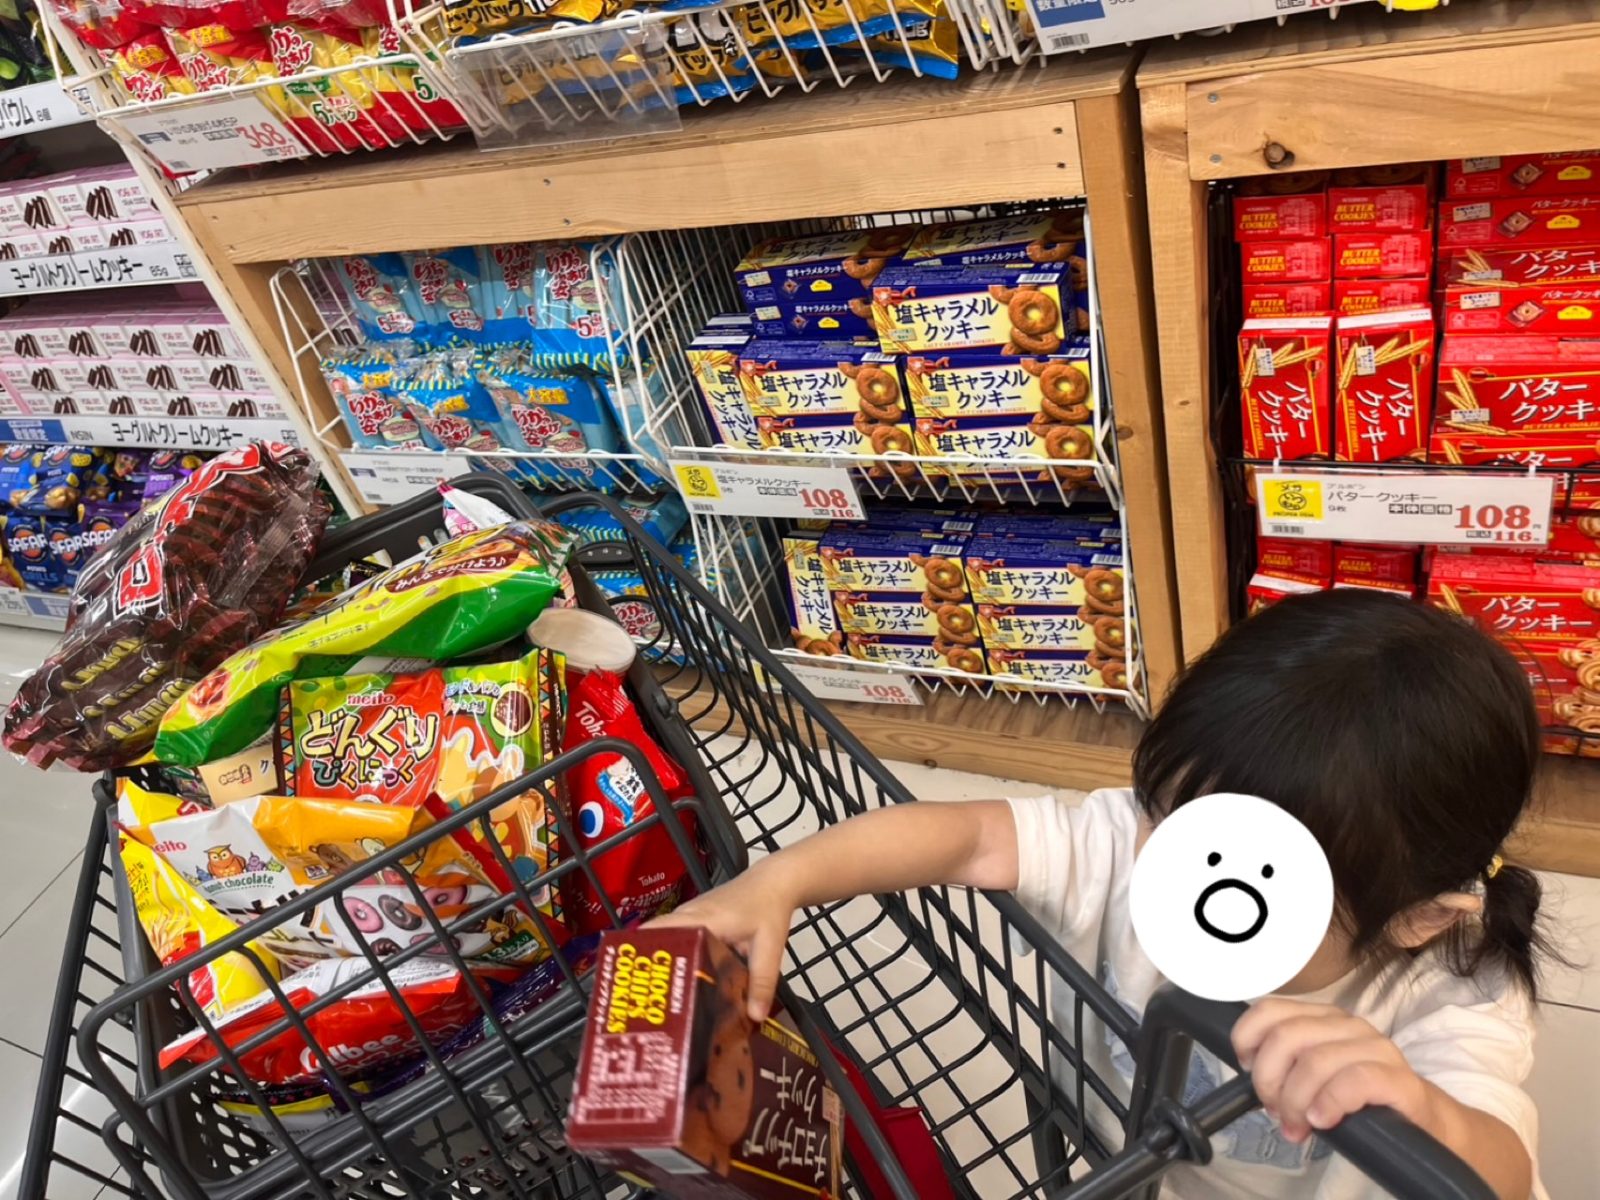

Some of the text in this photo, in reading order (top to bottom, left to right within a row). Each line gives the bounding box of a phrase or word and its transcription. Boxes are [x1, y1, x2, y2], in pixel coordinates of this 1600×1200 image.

[235, 122, 287, 149] 368
[10, 255, 143, 289] ヨーグルトクリームクッキー
[896, 298, 999, 324] 塩キャラメル
[924, 323, 990, 342] クッキー
[761, 372, 847, 393] 塩キャラメル
[928, 370, 1030, 392] 塩キャラメル
[1500, 378, 1588, 400] バター
[788, 391, 842, 408] クッキー
[957, 389, 1022, 409] クッキー
[1387, 378, 1414, 436] バター
[708, 389, 739, 442] クッキー
[1285, 381, 1313, 438] バター
[1511, 399, 1600, 423] クッキ
[112, 420, 243, 447] ヨーグルトクリームクッキー
[1258, 390, 1288, 460] クッキー
[1356, 389, 1387, 462] クッキー
[777, 430, 863, 449] 塩キャラメル
[936, 431, 1036, 453] 塩キャラメル
[717, 474, 811, 488] 塩キャラメルクッキー
[799, 488, 849, 509] 108
[1328, 491, 1437, 503] バタークッキー
[831, 509, 855, 518] 116
[1455, 504, 1530, 529] 108
[1494, 530, 1532, 542] 116
[838, 560, 917, 573] 塩キャラメル
[861, 573, 912, 586] クッキー
[987, 571, 1075, 586] 塩キャラメル
[795, 575, 813, 625] クッキー
[1011, 587, 1068, 600] クッキー
[852, 606, 930, 618] 塩キャラメル
[1482, 597, 1560, 613] バター
[875, 619, 924, 630] クッキー
[998, 618, 1085, 632] 塩キャラメル
[1494, 614, 1592, 631] クッキー
[1022, 633, 1078, 645] クッキー
[864, 645, 940, 660] 塩キャラメル
[1007, 662, 1093, 676] 塩キャラメル
[347, 693, 396, 706] meito
[861, 685, 905, 698] 108
[301, 707, 439, 761] どんぐり
[313, 755, 415, 792] ぴくにっく
[150, 840, 187, 854] eito
[224, 874, 275, 890] chocolate
[639, 872, 666, 887] Tohato
[607, 943, 636, 1034] COOKIES
[629, 956, 651, 1019] CHIPS
[646, 950, 672, 1025] CHOCO
[300, 1033, 399, 1074] Clbee
[760, 1056, 816, 1123] クッキー
[743, 1107, 827, 1183] チョコチップ
